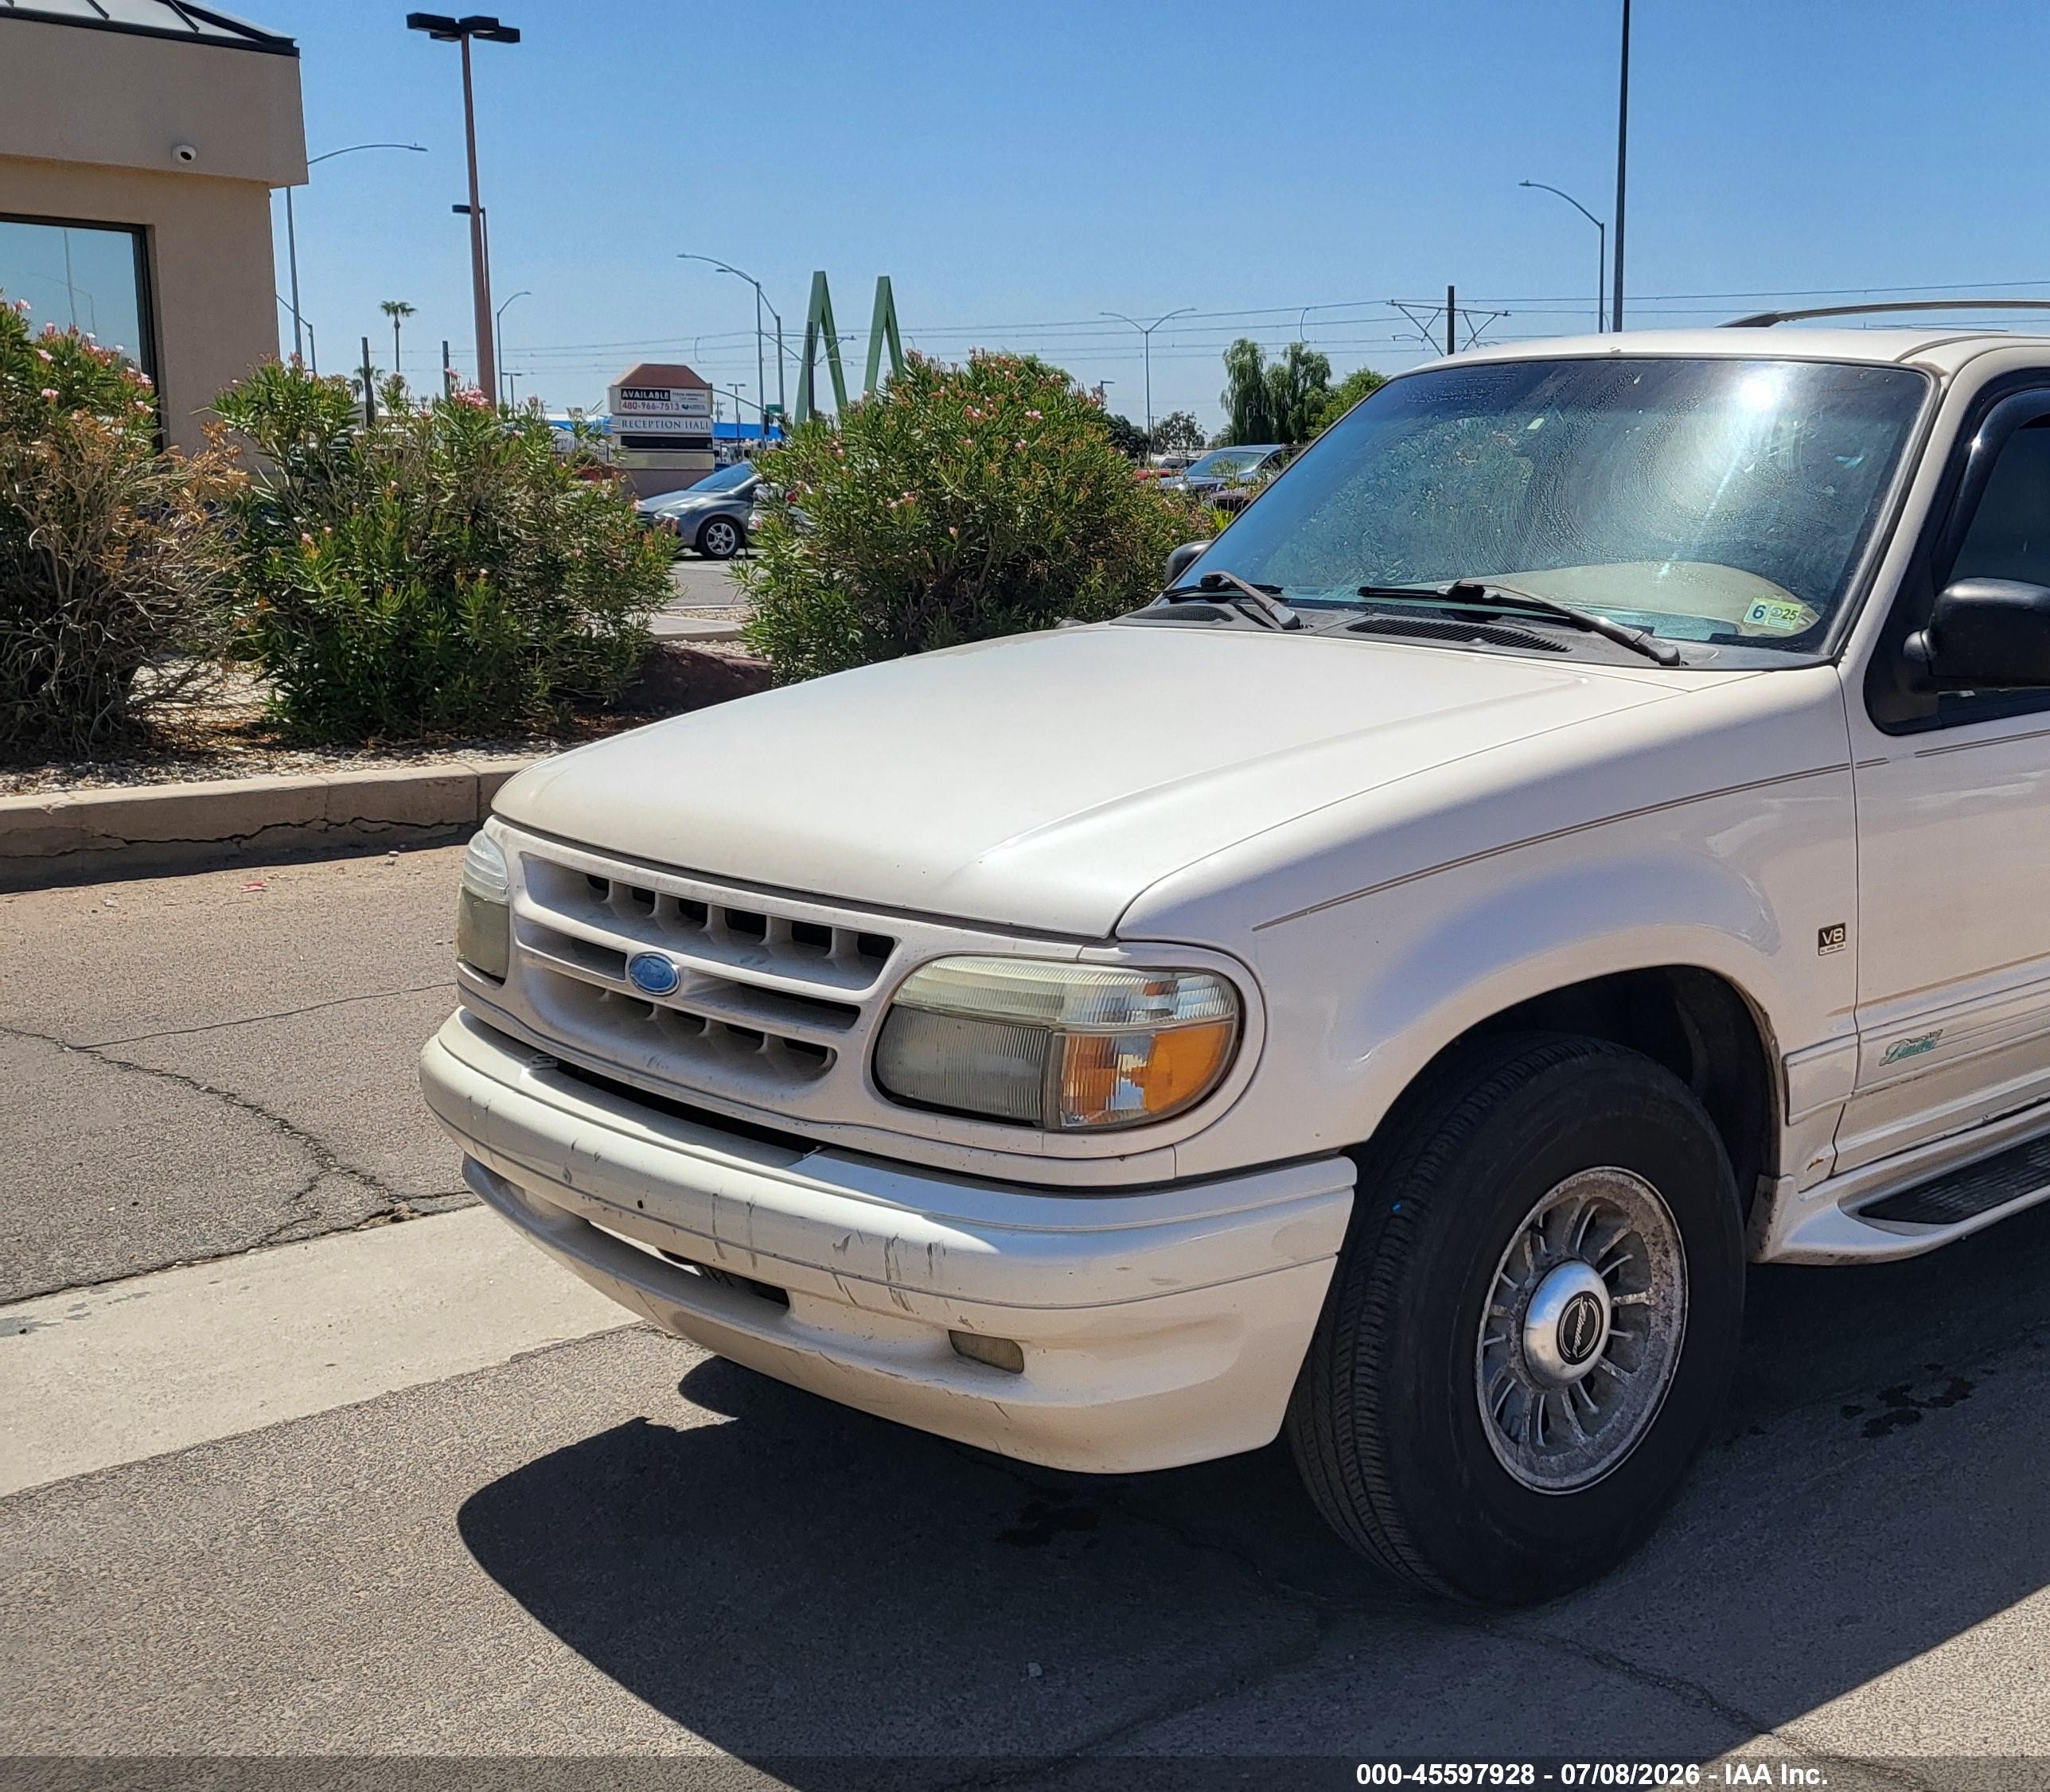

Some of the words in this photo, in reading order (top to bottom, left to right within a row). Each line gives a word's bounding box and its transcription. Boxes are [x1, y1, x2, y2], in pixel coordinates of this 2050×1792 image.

[622, 389, 669, 399] AVAILABLE
[622, 401, 680, 411] 480-966-7513
[622, 419, 681, 430] RECEPTION
[684, 420, 710, 430] HALL
[1752, 605, 1767, 619] 6
[1781, 609, 1799, 621] 25
[1822, 928, 1844, 945] V8
[1573, 1295, 1588, 1358] Limited
